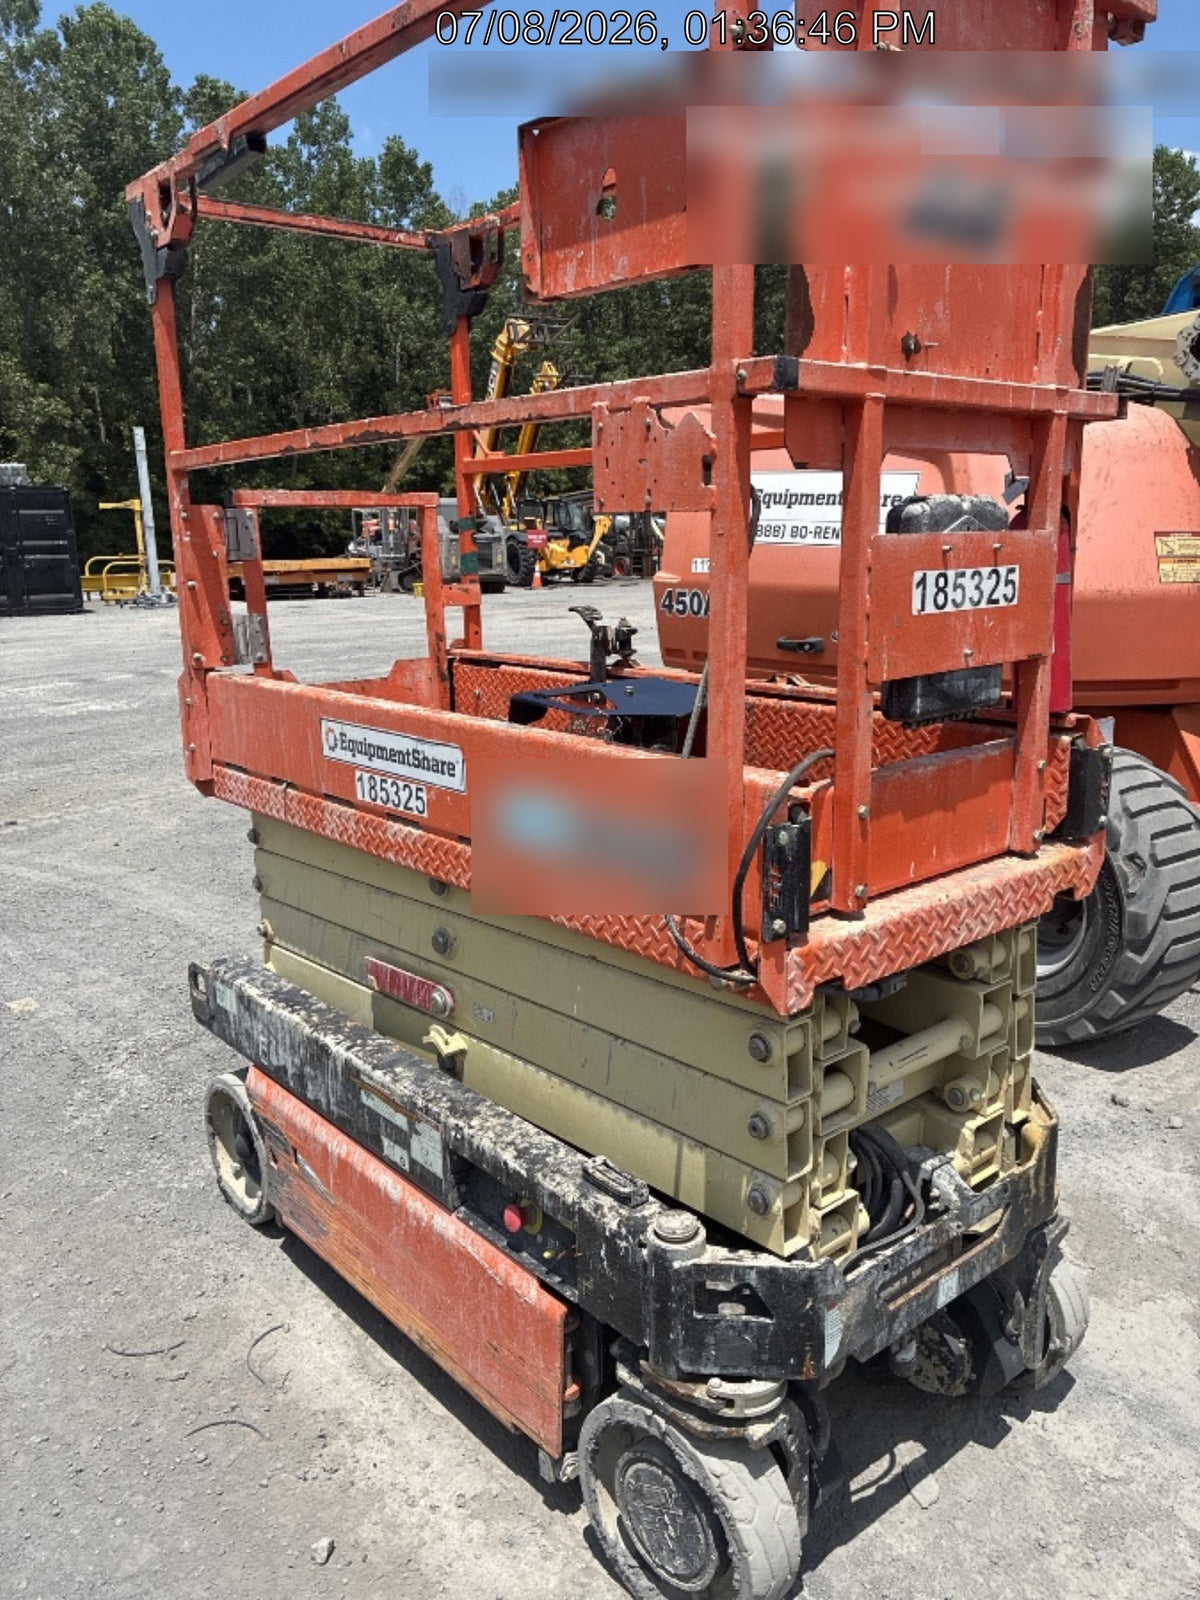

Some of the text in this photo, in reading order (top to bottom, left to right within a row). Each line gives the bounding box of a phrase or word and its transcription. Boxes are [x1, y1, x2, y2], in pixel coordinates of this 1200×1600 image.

[790, 525, 841, 540] 80-REN
[915, 567, 1016, 612] 185325
[339, 732, 456, 778] EquipmentShare
[357, 773, 426, 815] 185325
